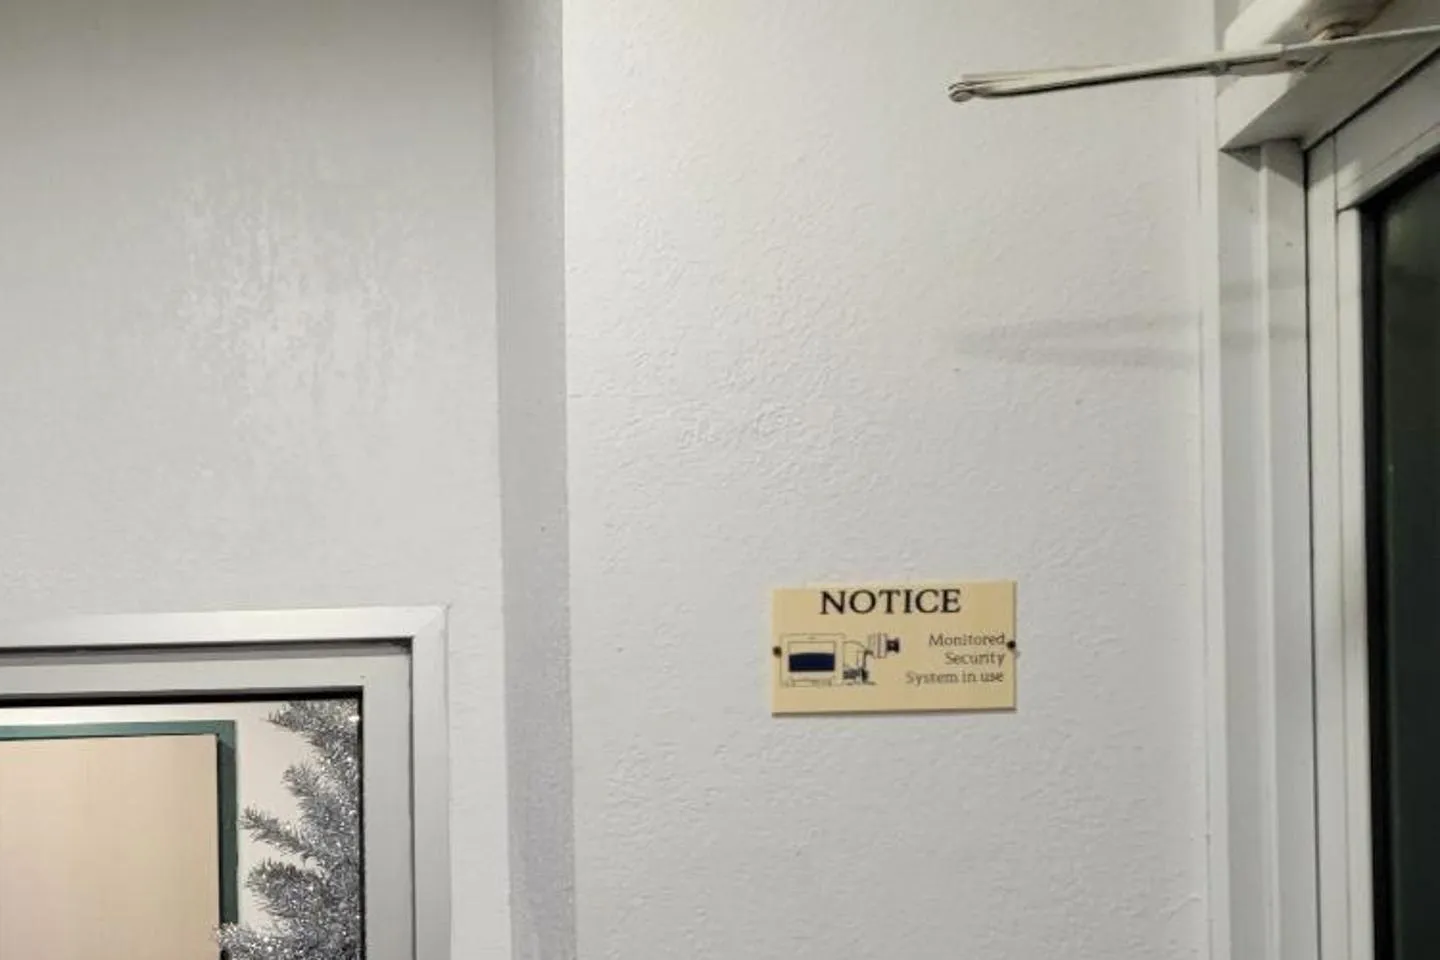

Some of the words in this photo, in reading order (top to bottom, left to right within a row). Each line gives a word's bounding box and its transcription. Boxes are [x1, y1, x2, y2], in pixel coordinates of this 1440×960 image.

[819, 588, 961, 615] NOTICE
[928, 633, 1006, 647] Monitored
[945, 651, 1006, 667] Security
[906, 672, 959, 686] System
[963, 671, 977, 683] in
[980, 673, 1004, 683] use
